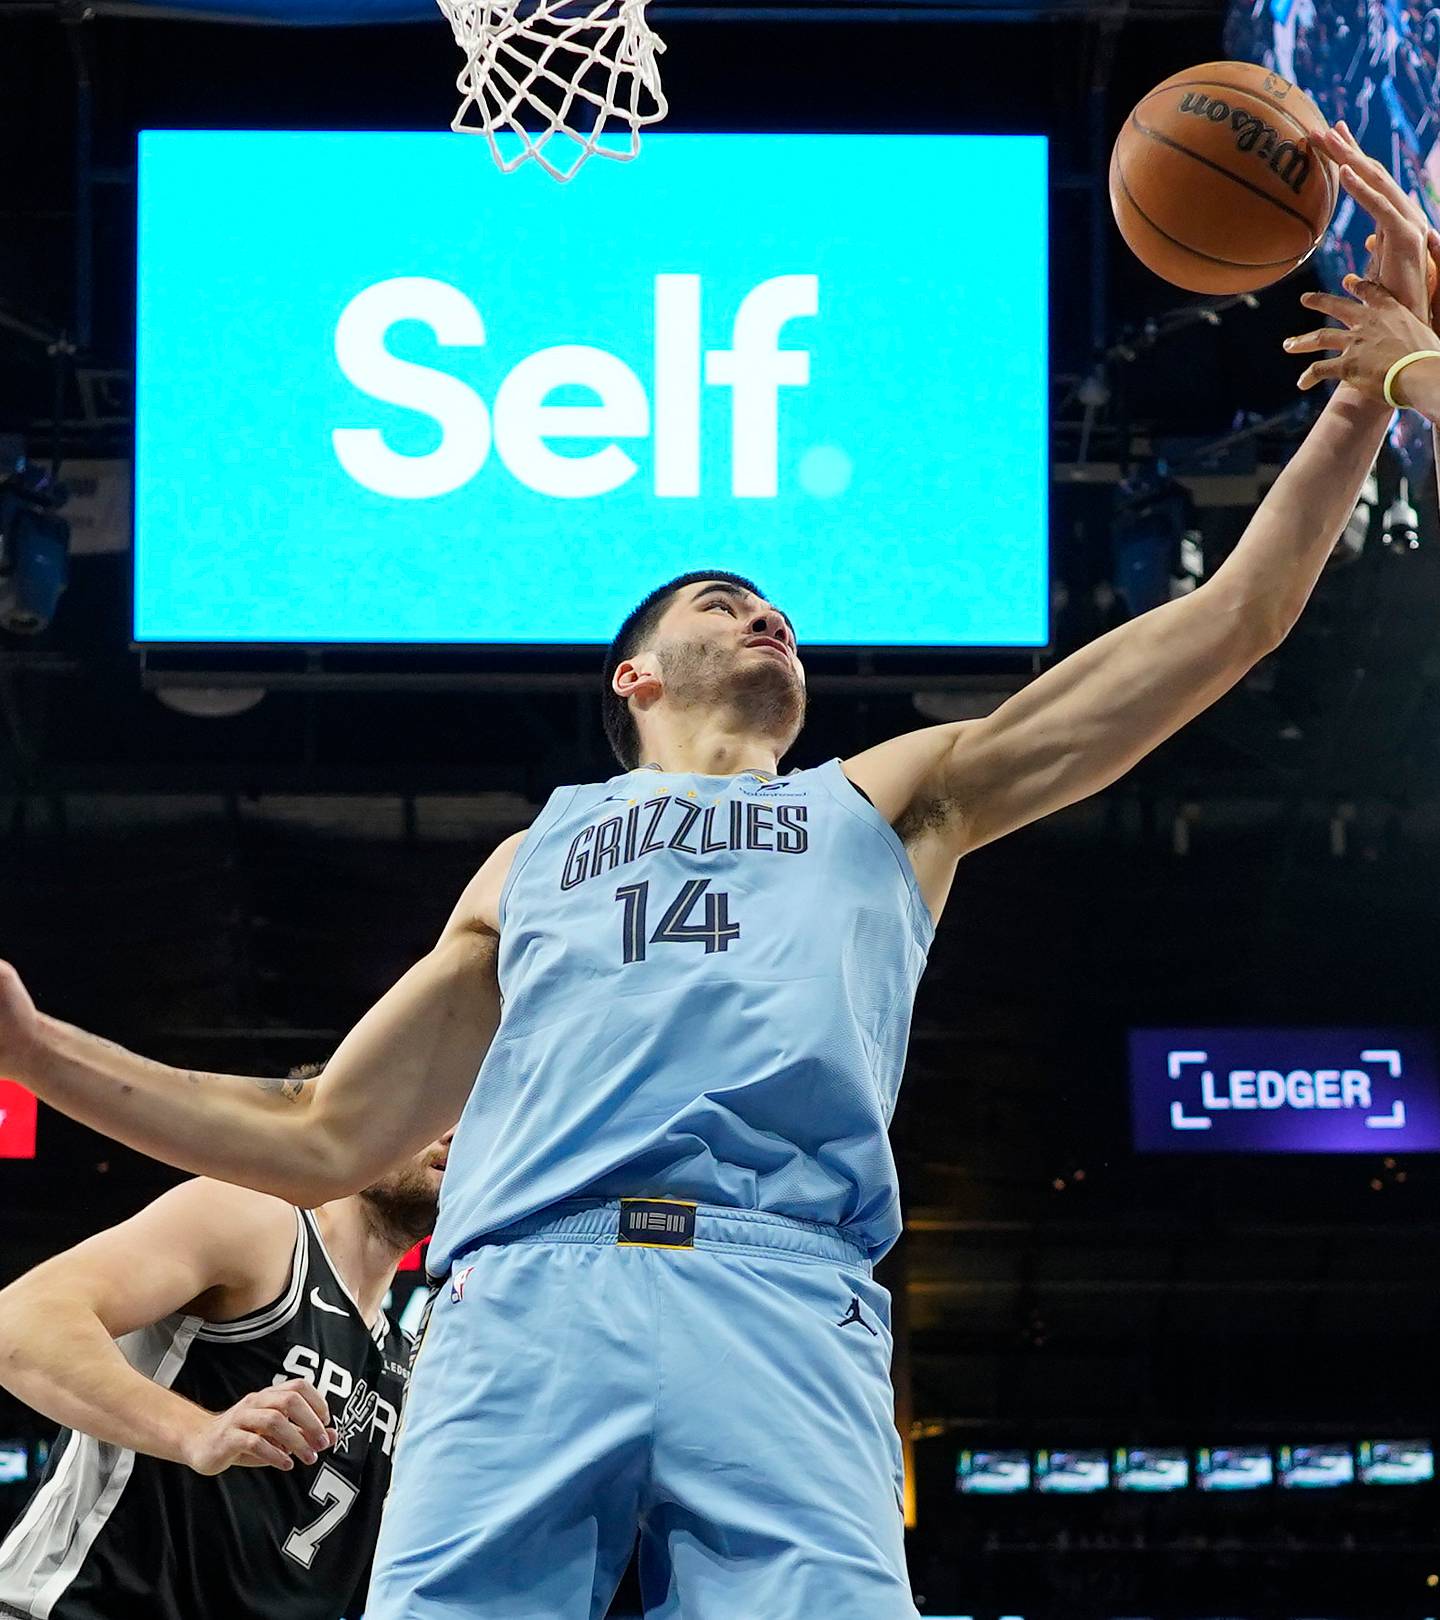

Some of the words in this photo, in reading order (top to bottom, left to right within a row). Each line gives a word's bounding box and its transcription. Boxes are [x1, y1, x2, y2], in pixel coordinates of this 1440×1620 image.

[1177, 92, 1311, 194] Wilson
[560, 796, 808, 891] GRIZZLIES
[614, 878, 741, 965] 14
[1201, 1070, 1372, 1110] LEDGER
[272, 1344, 398, 1457] SPUR
[281, 1461, 360, 1570] 7
